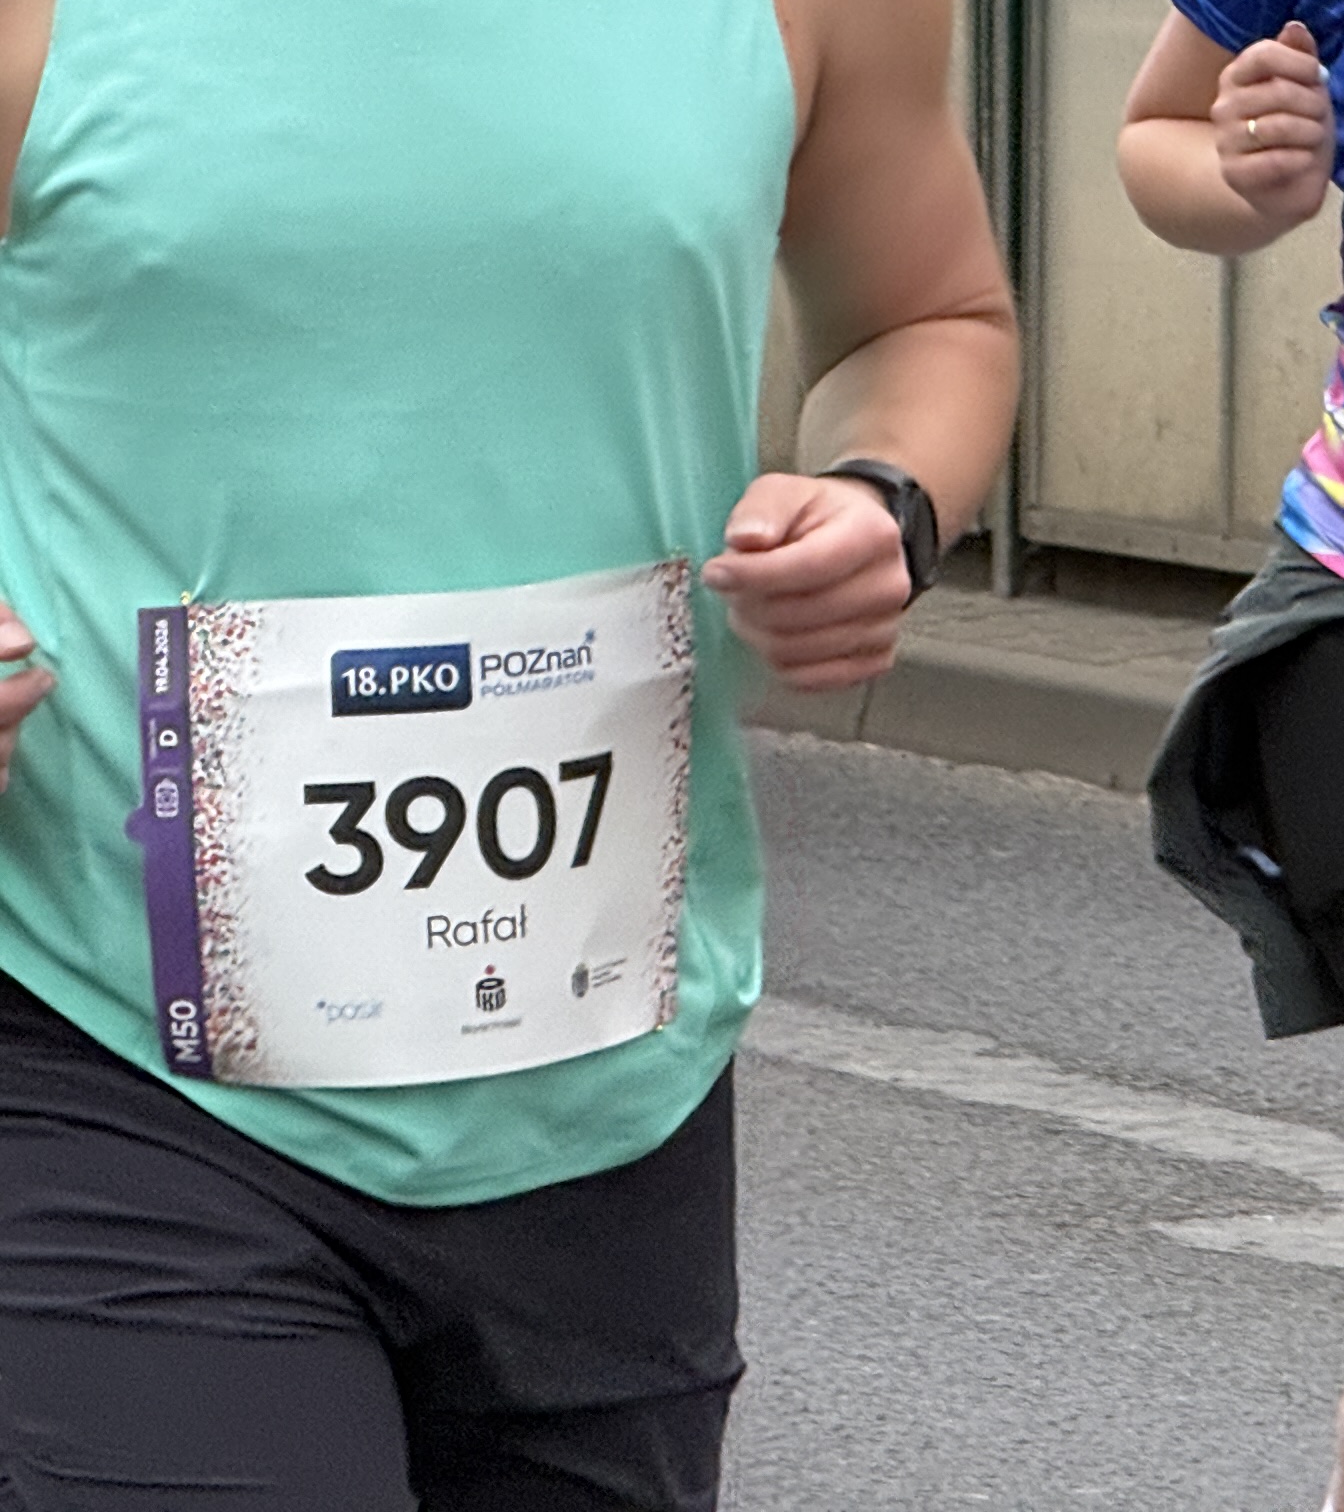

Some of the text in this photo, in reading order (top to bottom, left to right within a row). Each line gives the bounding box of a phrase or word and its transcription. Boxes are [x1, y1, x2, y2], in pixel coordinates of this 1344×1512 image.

[341, 659, 461, 698] 18.PKO
[158, 728, 179, 748] D
[303, 750, 613, 897] 3907
[426, 903, 528, 950] Rafał
[168, 999, 203, 1064] M50
